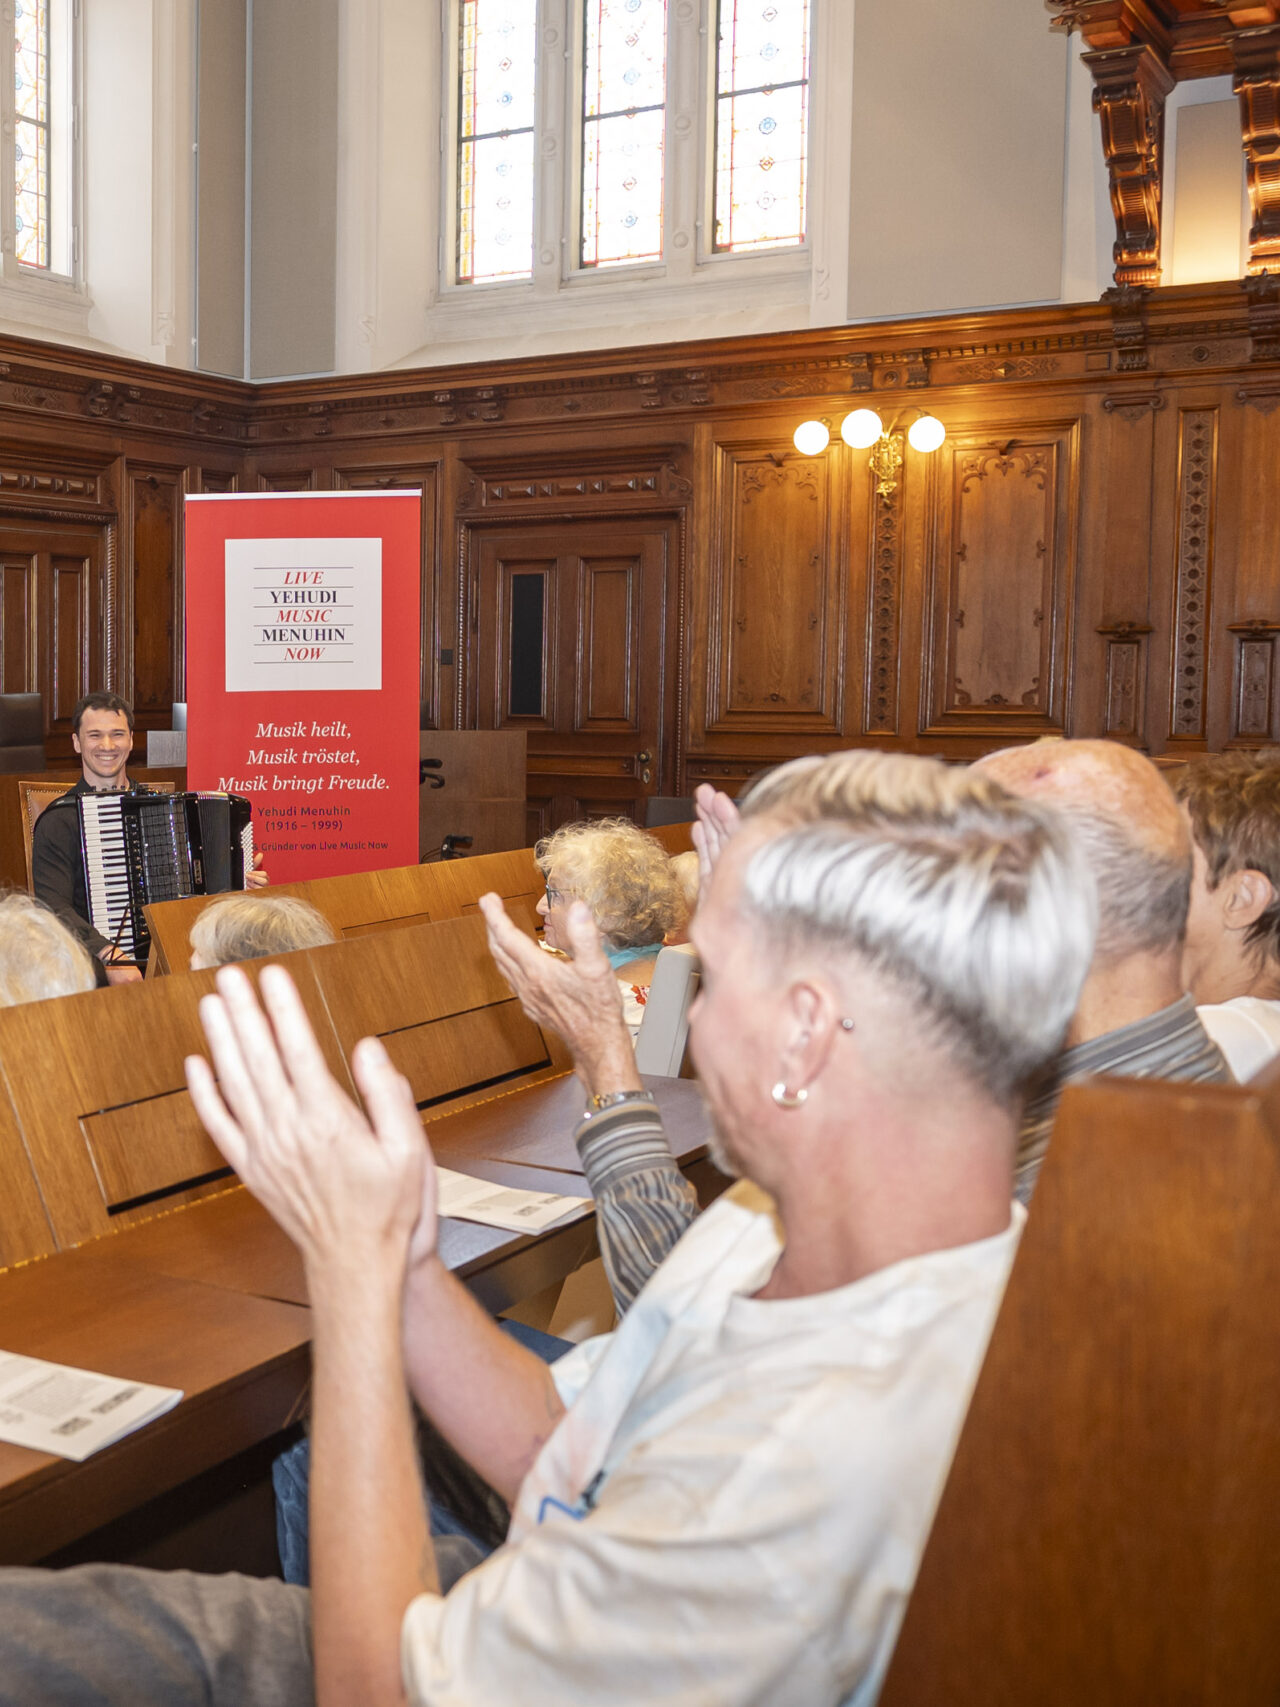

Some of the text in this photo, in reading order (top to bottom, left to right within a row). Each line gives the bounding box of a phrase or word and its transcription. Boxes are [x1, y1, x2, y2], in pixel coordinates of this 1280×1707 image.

[283, 571, 324, 585] LIVE
[270, 590, 337, 604] YEHUDI
[276, 609, 333, 623] MUSIC
[262, 628, 345, 642] MENUHIN
[283, 647, 326, 661] NOW
[255, 721, 352, 740] Musik heilt,
[246, 748, 361, 766] Musik tröstet,
[218, 774, 390, 794] Musik bringt Freude.
[258, 805, 351, 817] Yehudi Menuhin
[265, 820, 298, 832] (1916
[312, 819, 343, 831] 1999)
[261, 842, 298, 851] Gründer
[300, 842, 317, 850] von
[319, 841, 337, 850] Live
[340, 841, 366, 850] Music
[368, 840, 389, 849] Now
